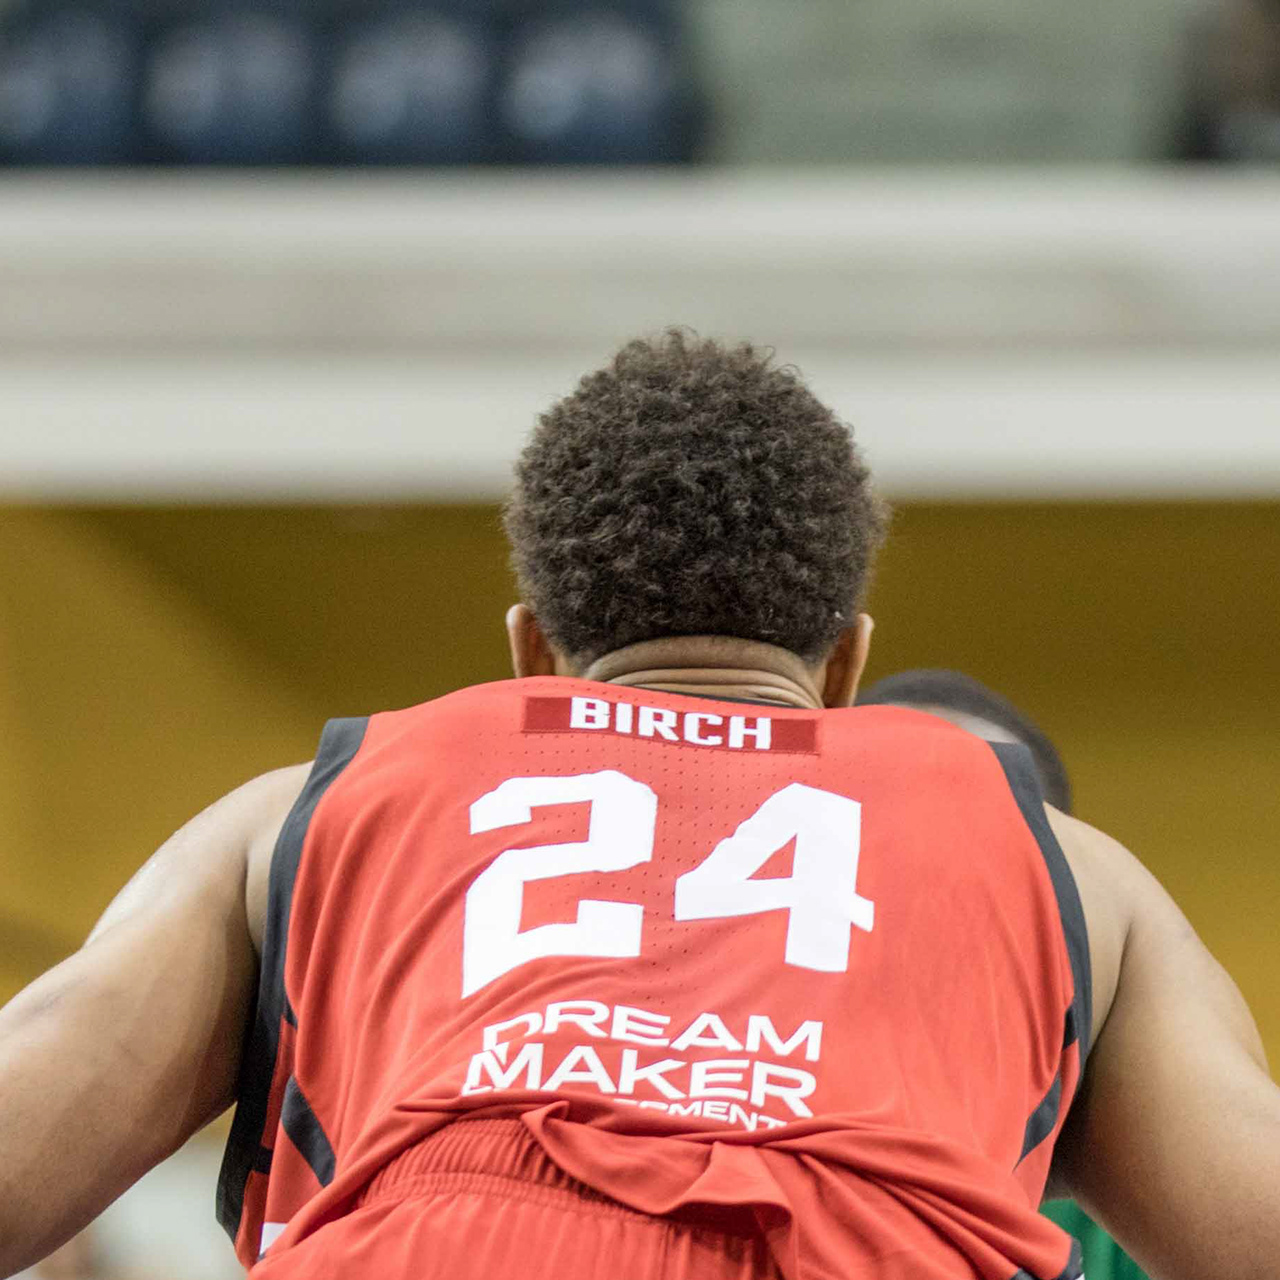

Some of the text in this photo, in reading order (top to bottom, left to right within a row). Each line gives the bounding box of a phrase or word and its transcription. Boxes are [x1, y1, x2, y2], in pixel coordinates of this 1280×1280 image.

[569, 697, 771, 749] BIRCH
[461, 770, 874, 999] 24
[482, 1000, 823, 1062] DREAM
[460, 1042, 818, 1118] MAKER
